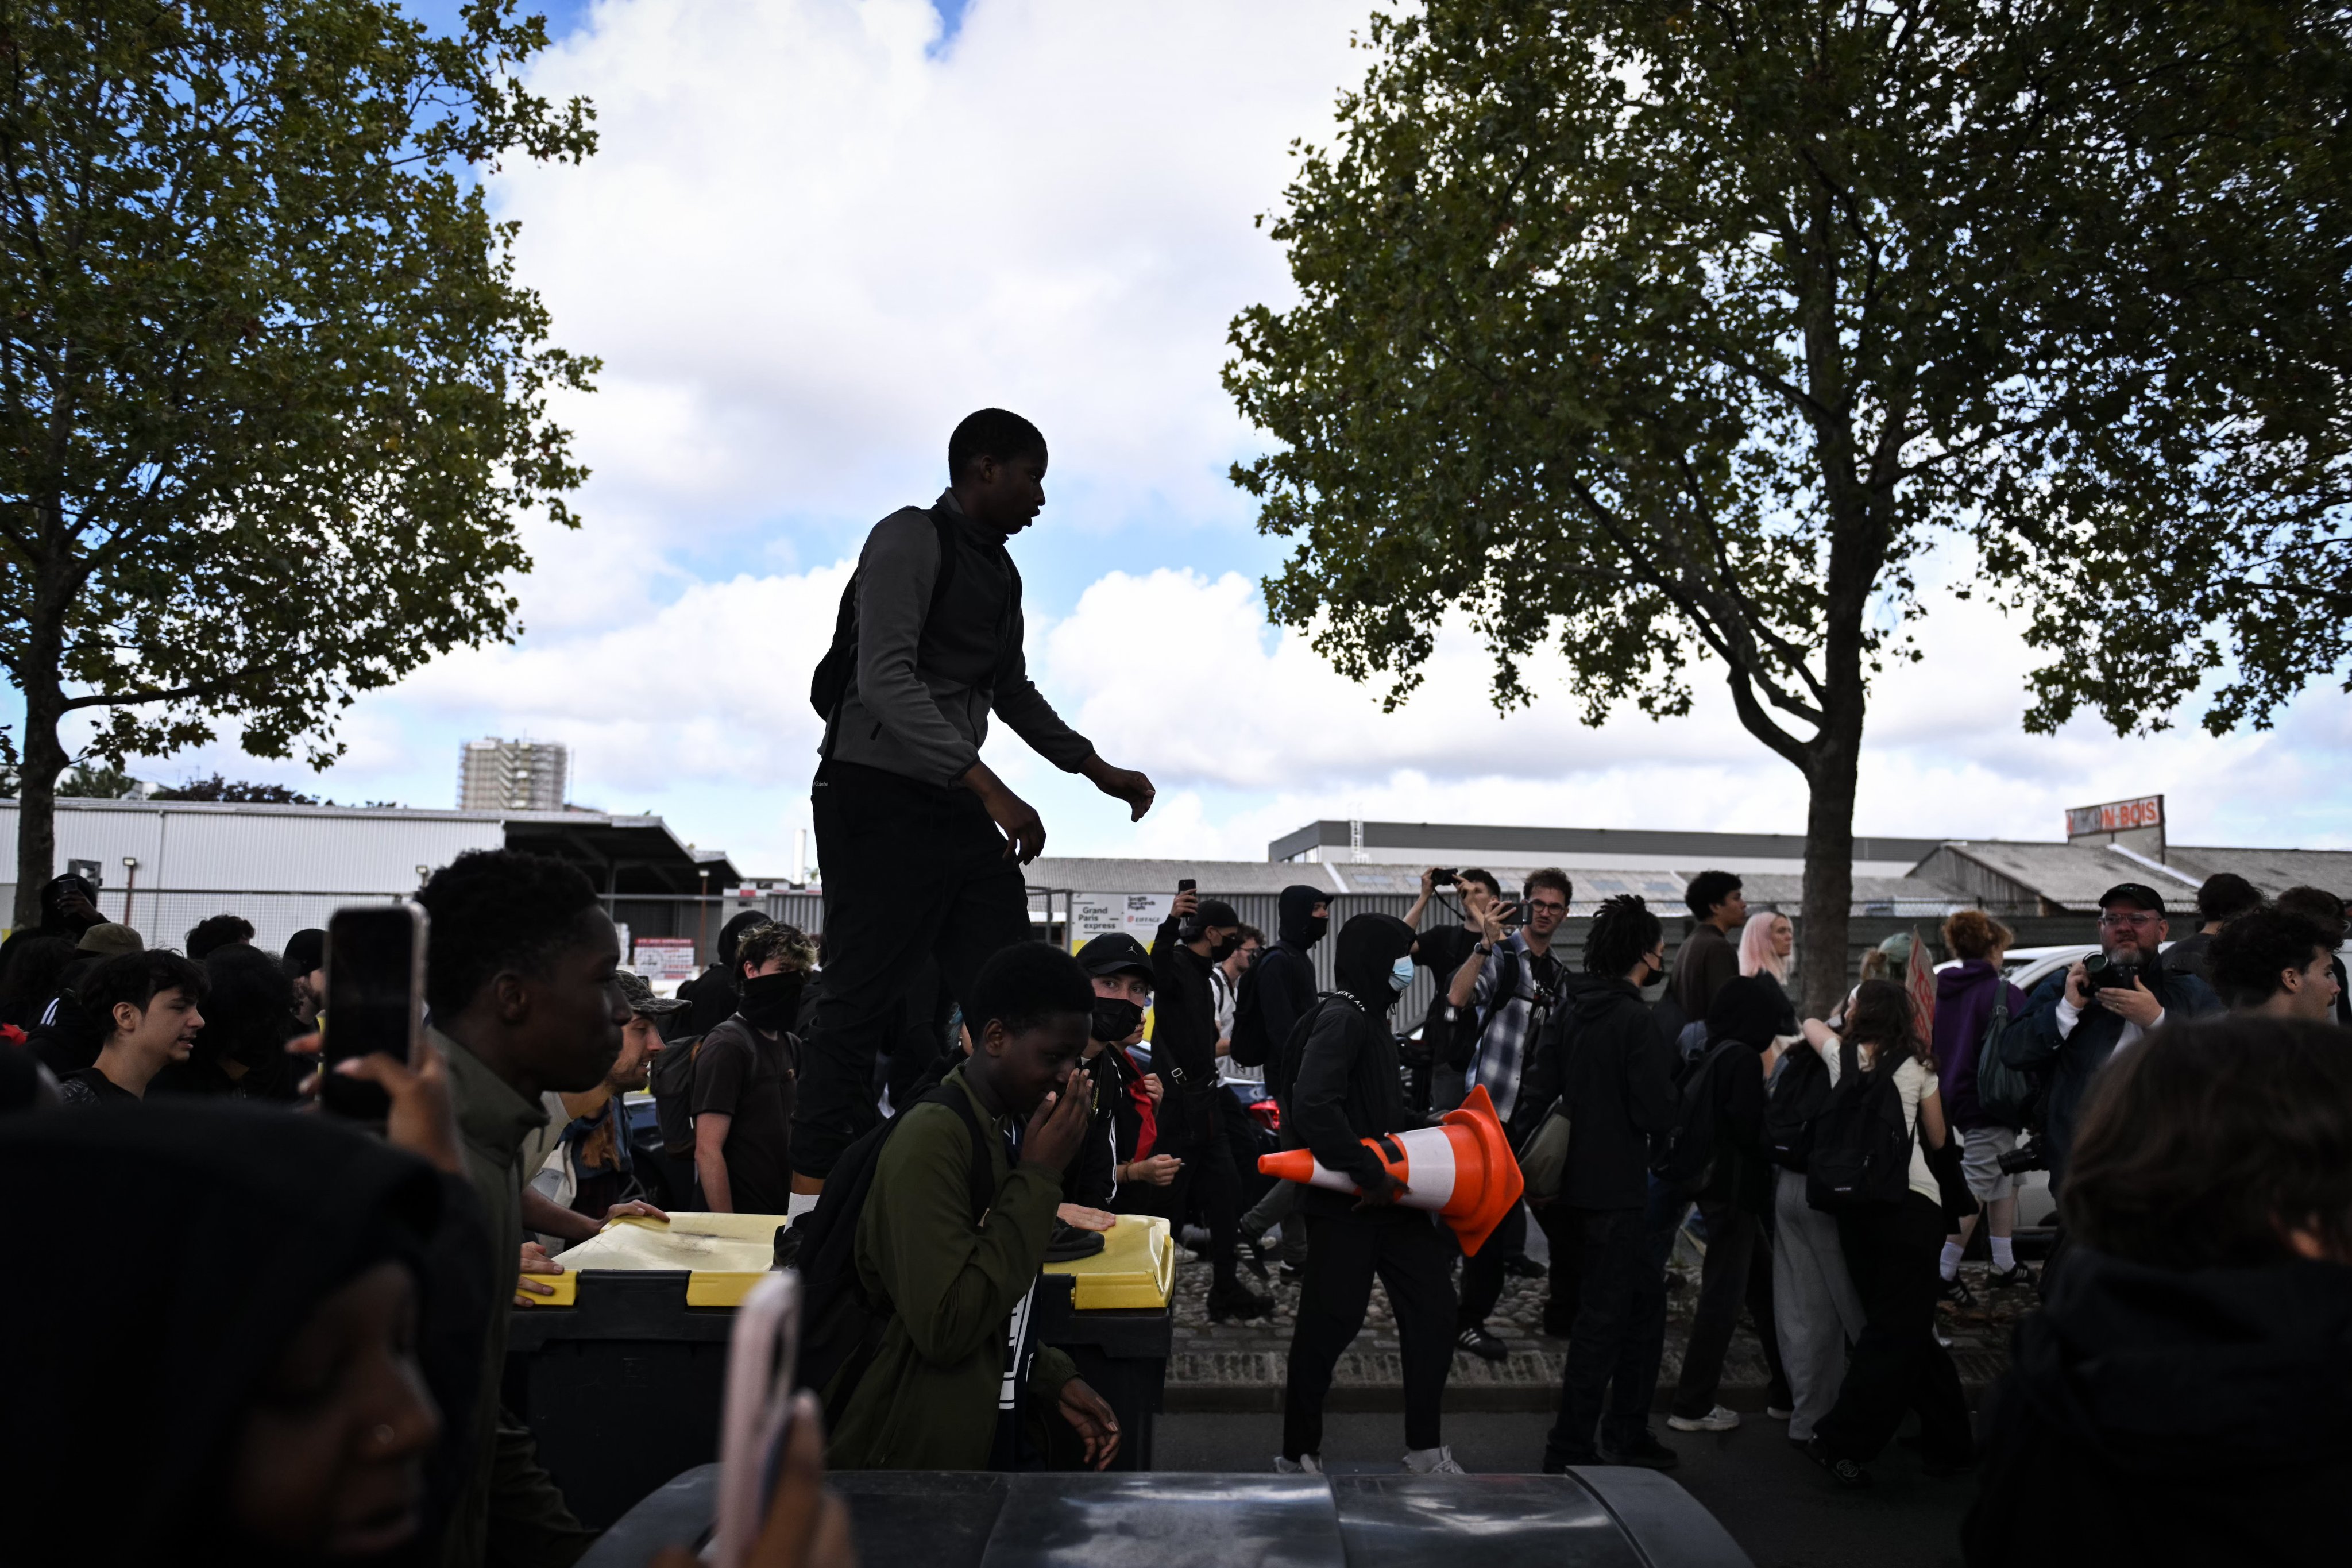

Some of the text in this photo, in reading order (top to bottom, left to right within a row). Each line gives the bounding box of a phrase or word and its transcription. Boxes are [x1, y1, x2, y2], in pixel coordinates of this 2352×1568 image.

[1083, 906, 1108, 914] Grand
[1337, 990, 1366, 1012] NIKE AIR
